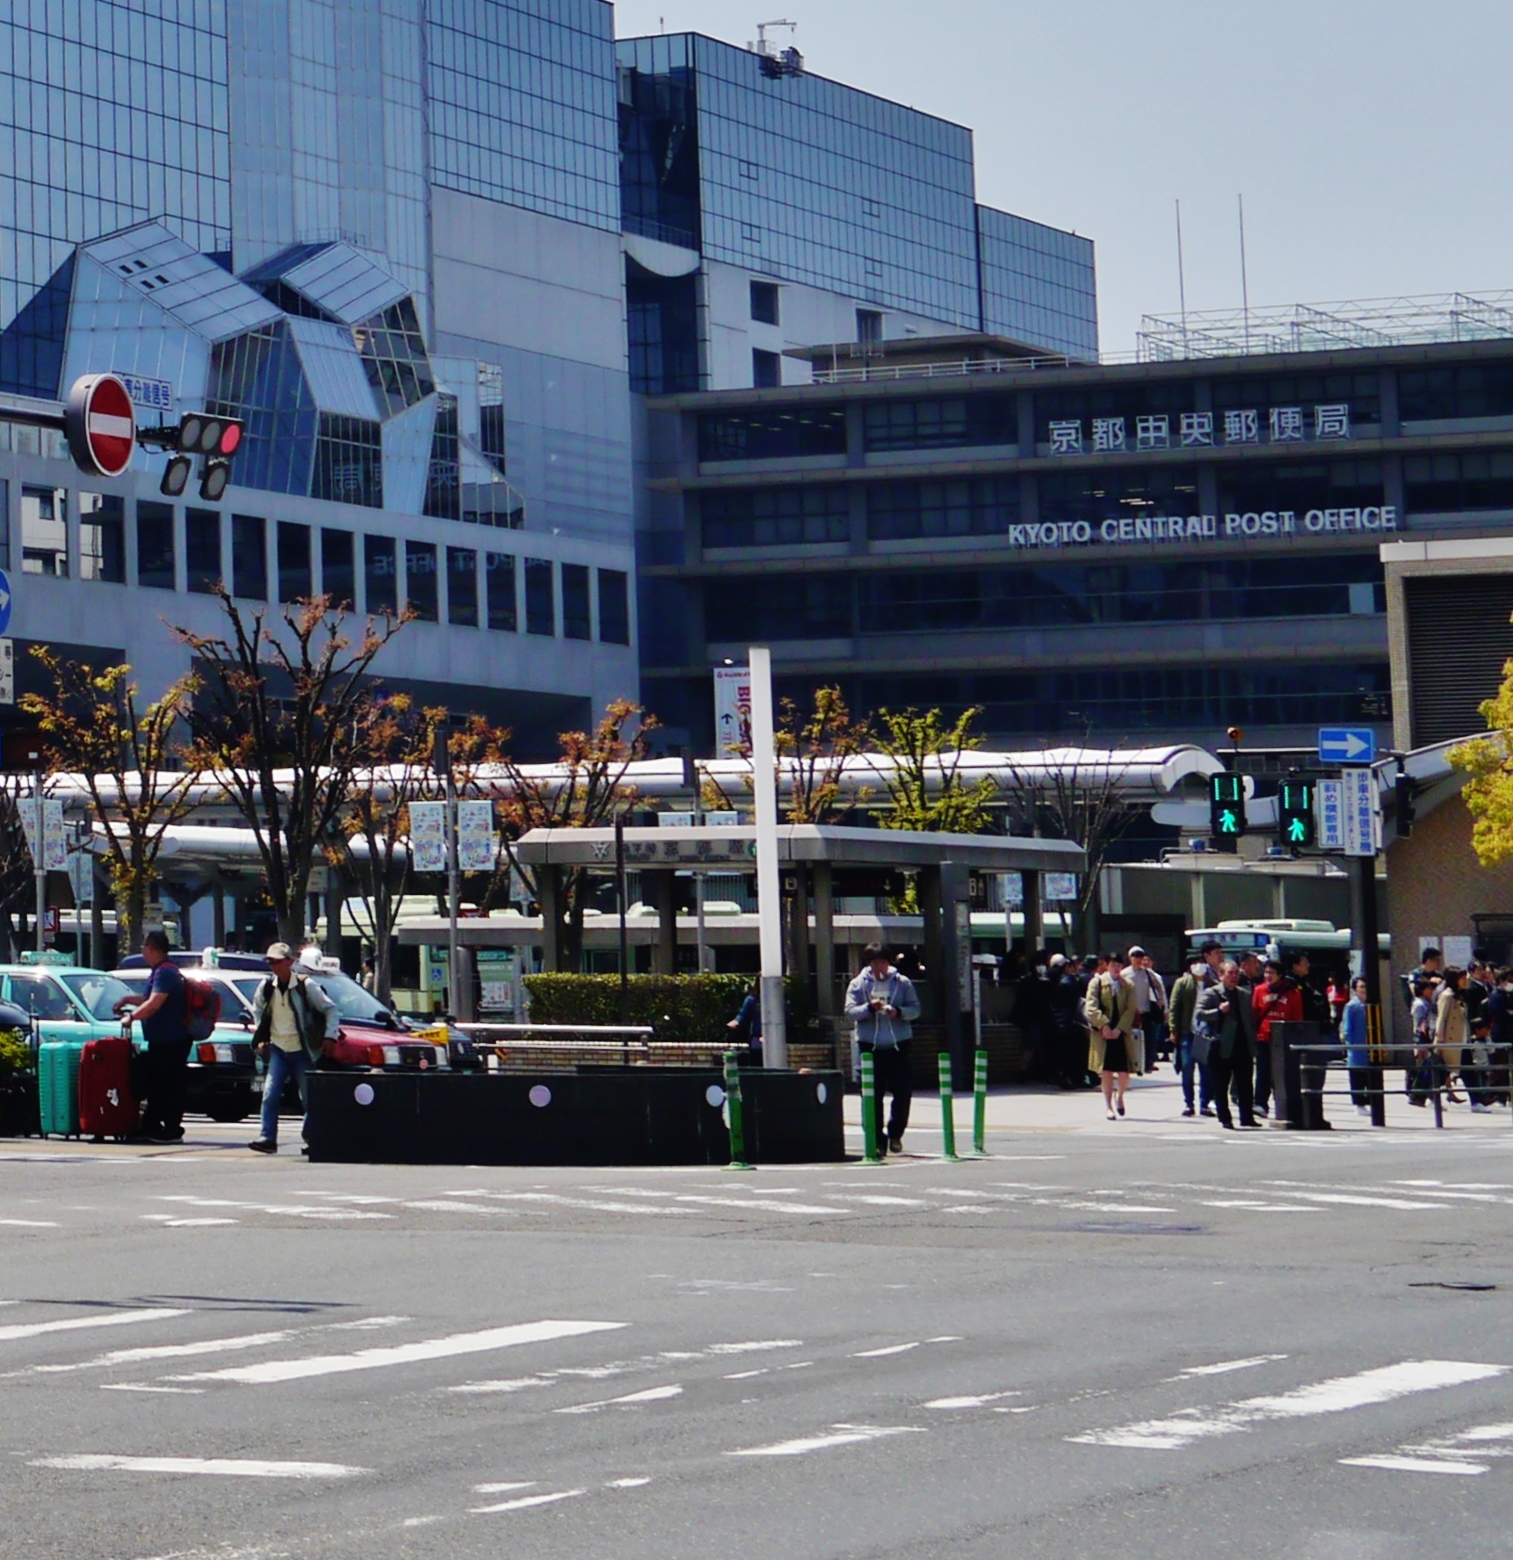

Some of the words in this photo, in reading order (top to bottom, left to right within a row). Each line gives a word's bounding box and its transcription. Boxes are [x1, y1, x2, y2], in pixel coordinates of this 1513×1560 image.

[125, 378, 170, 407] 車分離信号
[1049, 404, 1349, 454] 京都中央郵便局
[1009, 520, 1091, 544] KYOTO
[1100, 515, 1215, 540] CENTRAL
[1225, 511, 1295, 535] POST
[1304, 506, 1396, 532] OFFICE
